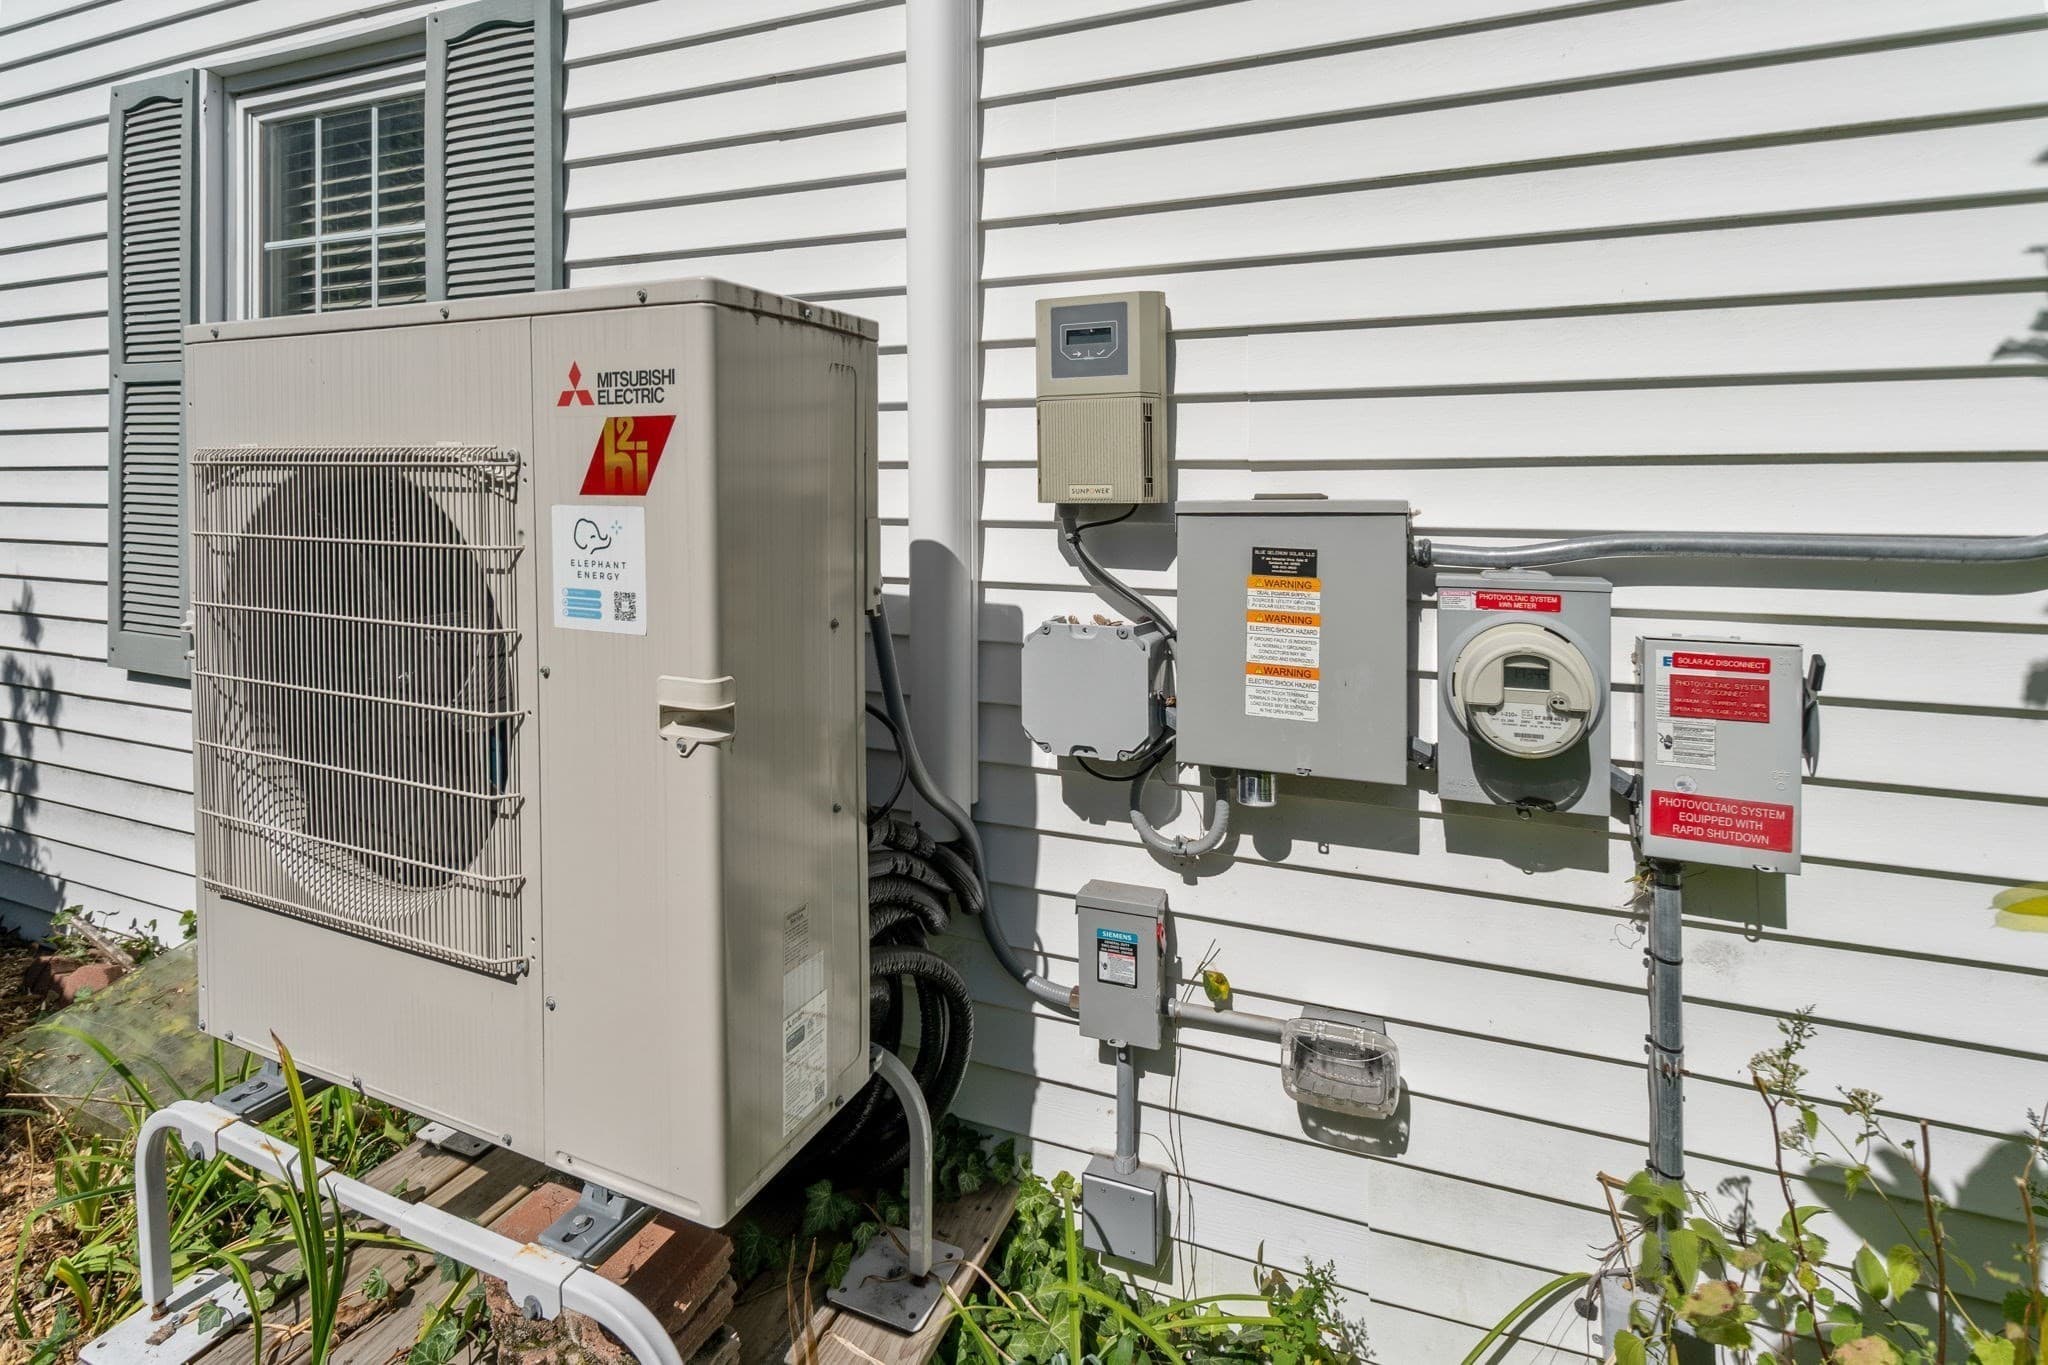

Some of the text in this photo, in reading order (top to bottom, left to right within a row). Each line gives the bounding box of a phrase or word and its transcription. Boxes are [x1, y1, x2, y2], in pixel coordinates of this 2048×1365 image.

[597, 368, 675, 388] MITSUBISHI
[597, 387, 664, 405] ELECTRIC
[1072, 487, 1110, 495] SUNPOWER
[570, 559, 627, 570] ELEPHANT
[577, 571, 620, 581] ENERGY
[1264, 579, 1312, 590] WARNING
[1478, 594, 1528, 602] PHOTOVOLTAIC
[1264, 614, 1312, 624] WARNING
[1678, 657, 1703, 665] SOLAR
[1716, 660, 1766, 669] DISCONNECT
[1264, 667, 1311, 678] WARNING
[1675, 680, 1730, 689] PHOTOVOLTAIC
[1704, 689, 1748, 697] DISCONNECT
[1659, 797, 1785, 820] PHOTOVOLTAIC SYSTEM
[1679, 812, 1763, 830] EQUIPPED WITH
[1673, 824, 1769, 844] RAPID SHUTDOWN
[1103, 931, 1132, 941] SIEMENS
